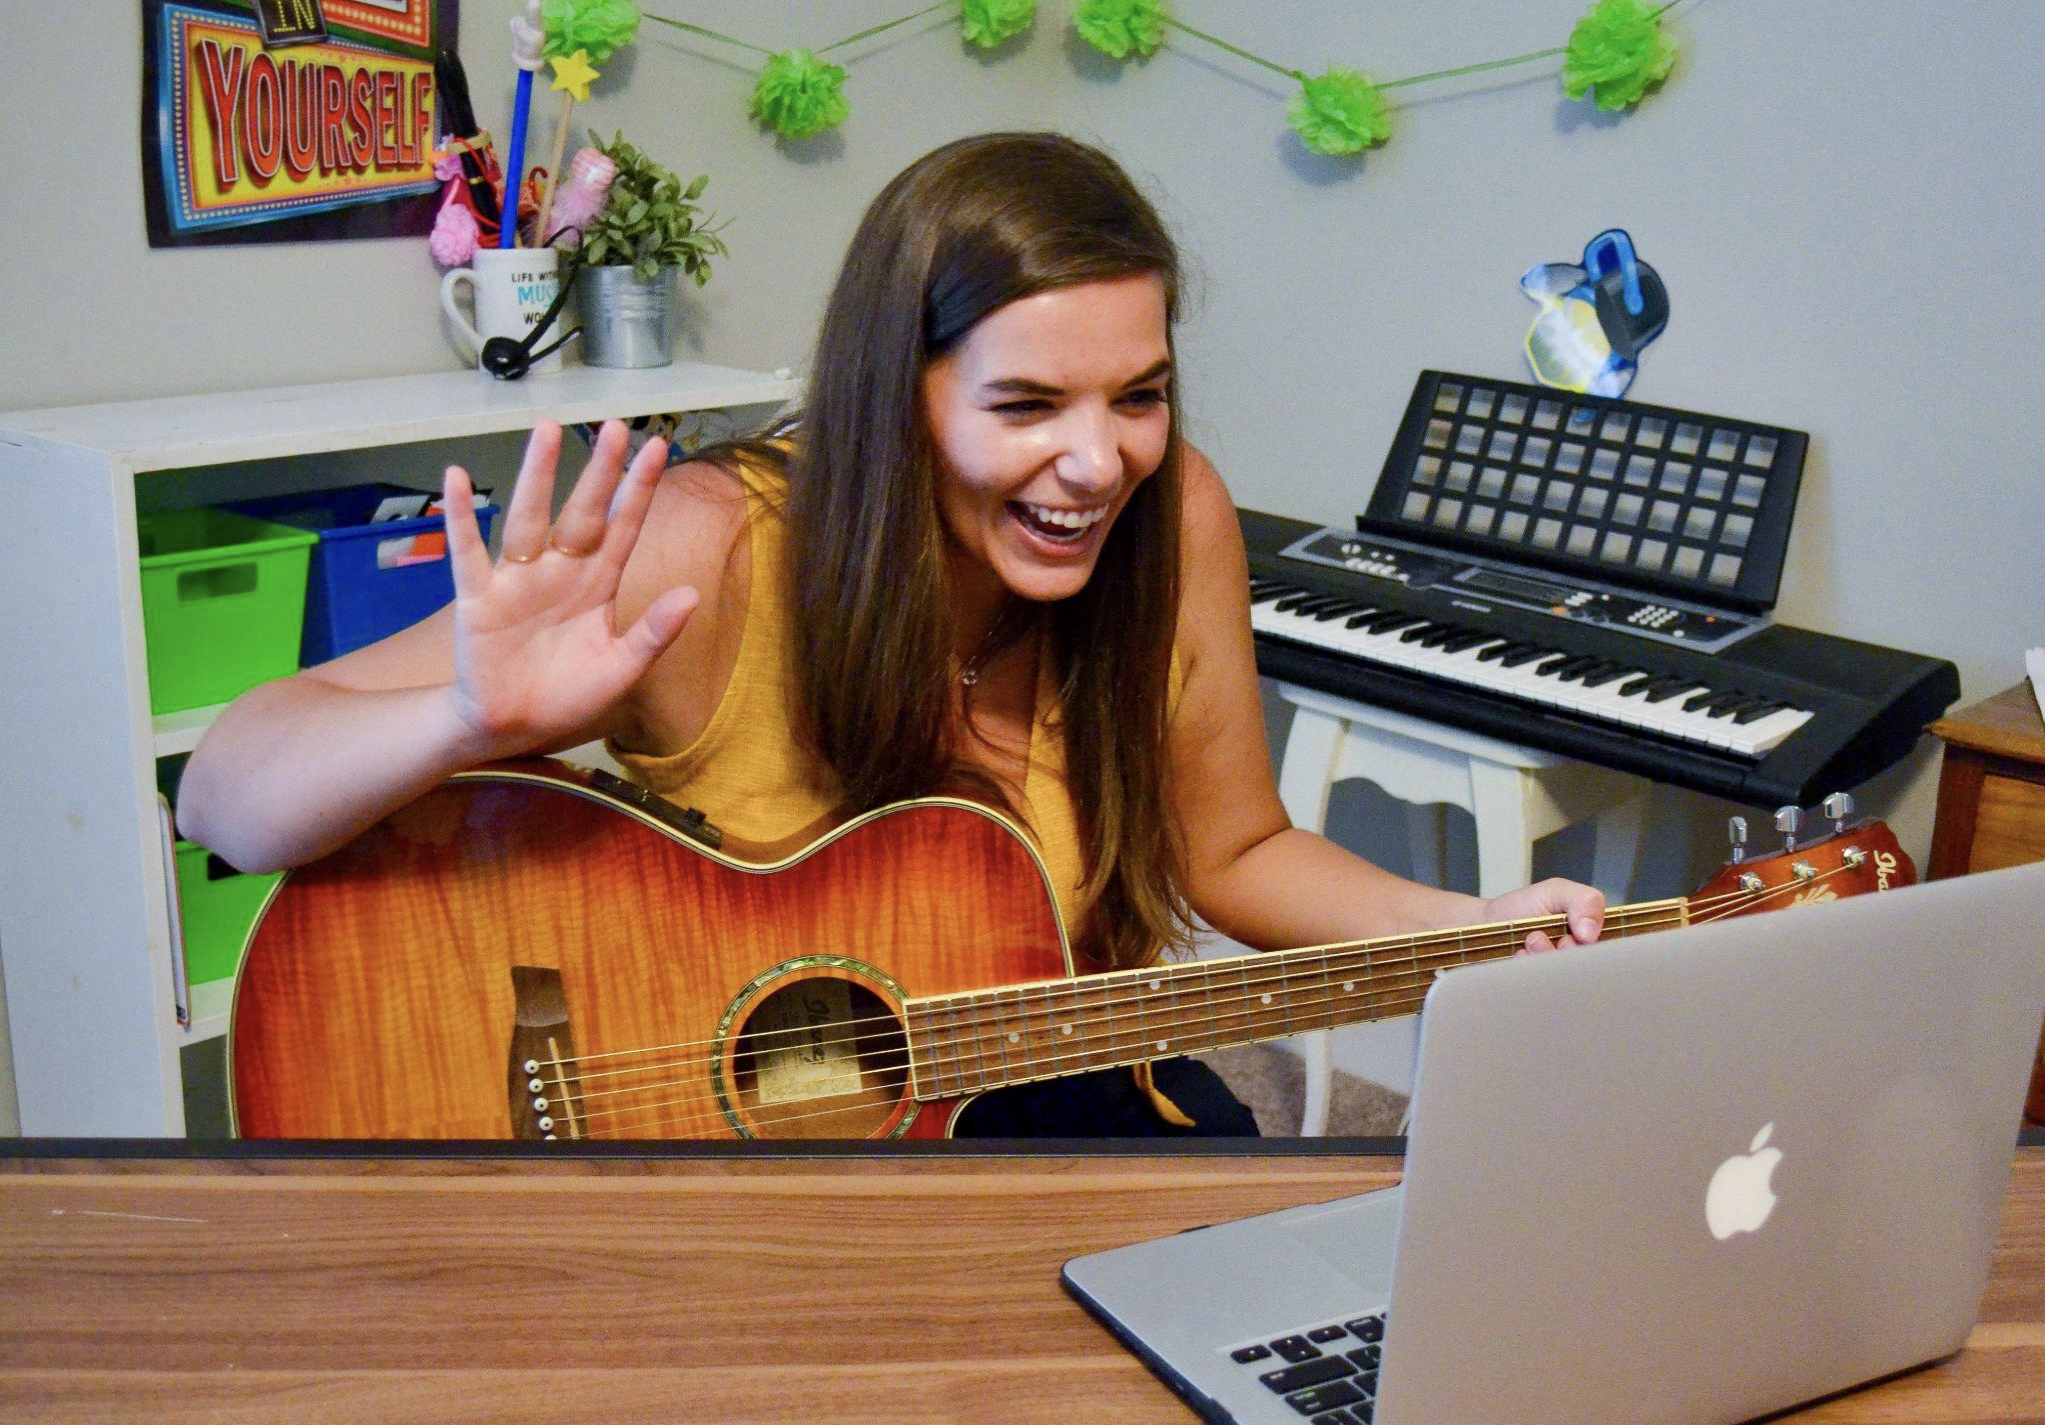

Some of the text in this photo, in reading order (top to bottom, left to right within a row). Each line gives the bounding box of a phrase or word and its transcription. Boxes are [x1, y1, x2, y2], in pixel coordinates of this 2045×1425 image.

[272, 0, 316, 33] IN
[197, 38, 432, 191] YOURSELF
[511, 273, 534, 283] LIFE
[517, 285, 558, 308] MUS
[523, 312, 545, 324] WO
[1873, 849, 1897, 892] Iba
